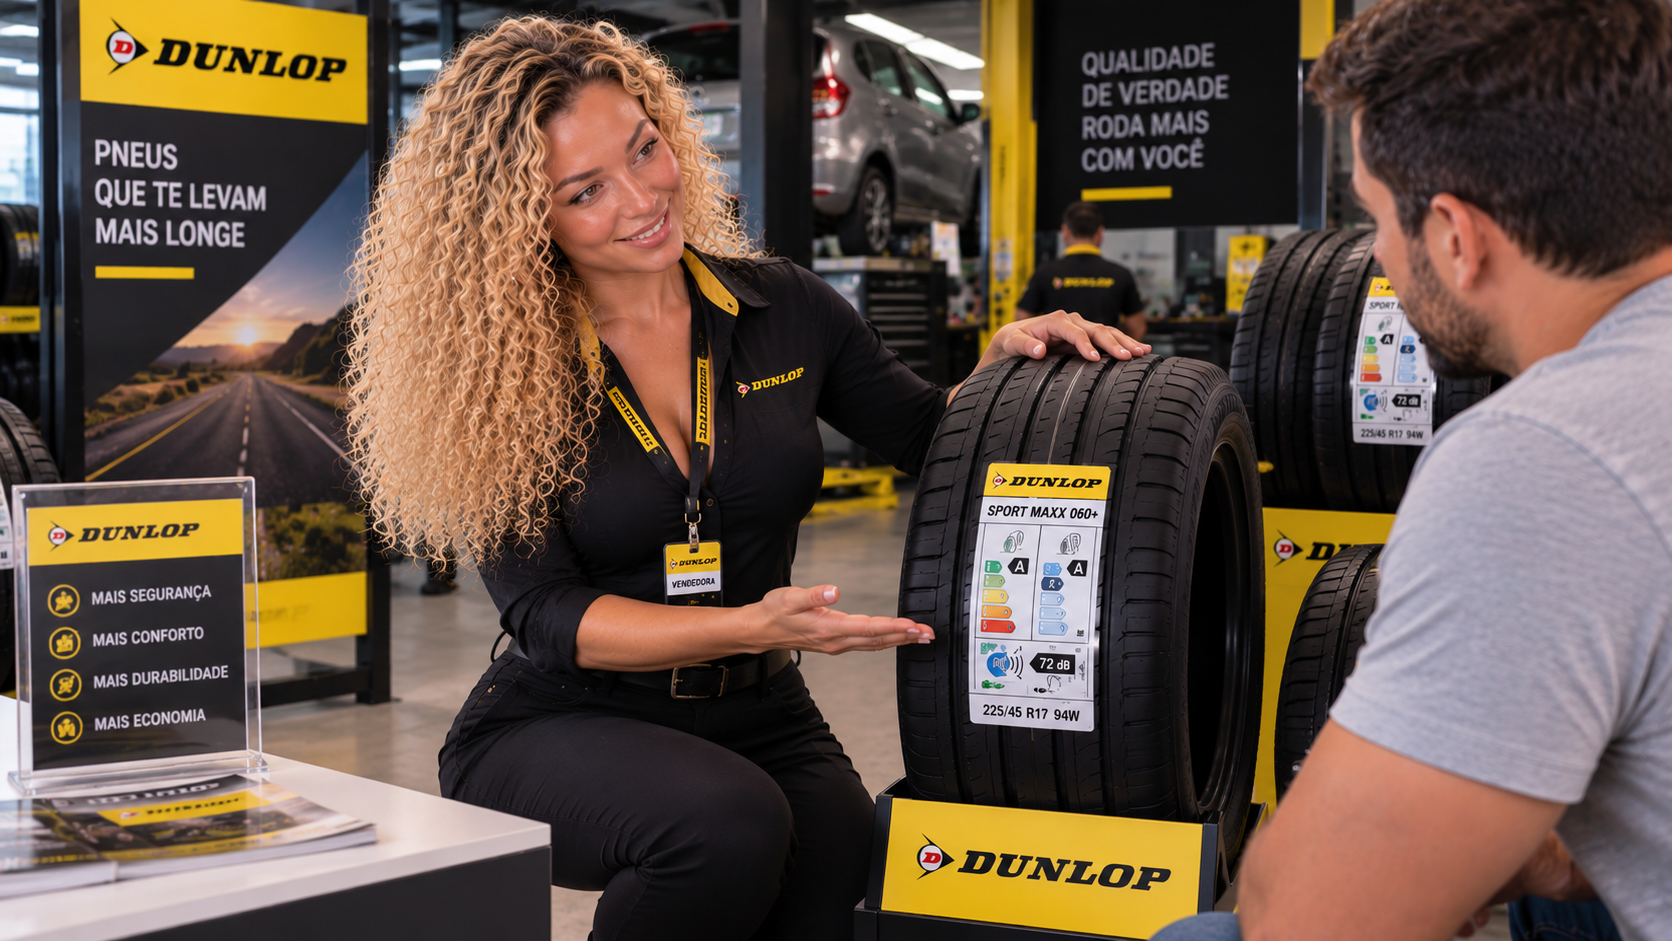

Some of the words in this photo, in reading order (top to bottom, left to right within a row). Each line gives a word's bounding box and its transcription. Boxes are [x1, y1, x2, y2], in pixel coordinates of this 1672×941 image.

[153, 38, 347, 82] DUNLOP
[1081, 42, 1215, 78] QUALIDADE
[1082, 82, 1113, 108] DE
[1117, 74, 1230, 105] VERDADE
[1081, 113, 1146, 140] RODA
[1150, 109, 1210, 137] MAIS
[94, 139, 178, 170] PNEUS
[1081, 146, 1135, 173] COM
[1139, 137, 1205, 170] VOCÊ
[94, 178, 146, 209] QUE
[152, 181, 182, 208] TE
[189, 182, 267, 212] LEVAM
[95, 217, 158, 245] MAIS
[166, 219, 245, 248] LONGE
[1369, 302, 1395, 310] SPORT
[1383, 335, 1391, 344] A
[751, 367, 804, 391] DUNLOP
[1361, 428, 1387, 439] 225/45
[1388, 429, 1403, 439] R17
[1406, 430, 1424, 440] 94W
[1009, 476, 1102, 488] DUNLOP
[987, 505, 1028, 517] SPORT
[1030, 506, 1067, 519] MAXX
[1069, 507, 1098, 520] 060+
[78, 522, 200, 543] DUNLOP
[679, 558, 717, 567] DUNLOP
[1014, 560, 1025, 573] A
[1073, 562, 1084, 575] A
[671, 577, 716, 589] VENDEDORA
[91, 589, 126, 605] MAIS
[129, 584, 212, 602] SEGURANÇA
[92, 631, 128, 648] MAIS
[131, 626, 204, 645] CONFORTO
[1039, 658, 1054, 670] 72
[1056, 660, 1071, 671] dB
[93, 673, 129, 689] MAIS
[132, 665, 229, 686] DURABILIDADE
[94, 714, 130, 731] MAIS
[133, 708, 206, 728] ECONOMIA
[983, 704, 1022, 718] 225/45
[1026, 707, 1048, 720] R17
[1054, 709, 1080, 722] 94W
[957, 849, 1172, 891] DUNLOP
